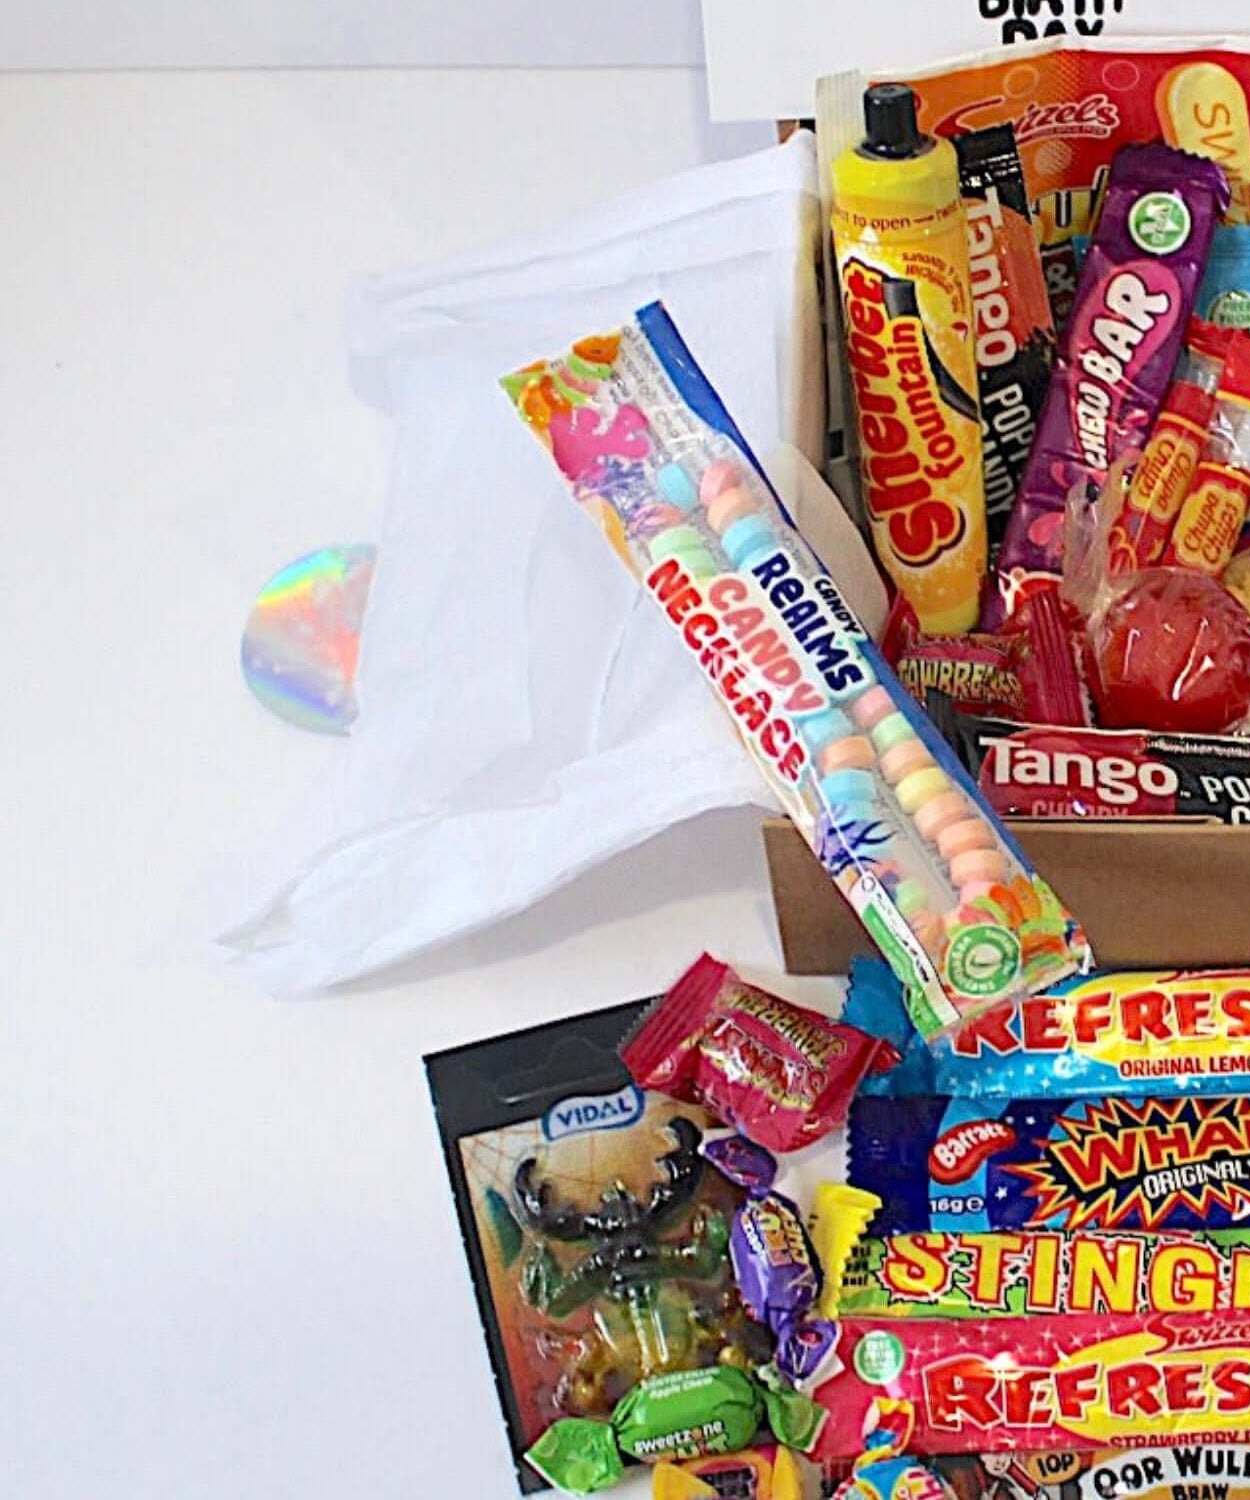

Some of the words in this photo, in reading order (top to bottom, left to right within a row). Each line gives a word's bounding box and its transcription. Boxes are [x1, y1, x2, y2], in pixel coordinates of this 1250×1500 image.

[967, 186, 1017, 366] Tango
[1080, 272, 1172, 386] BAR
[845, 266, 957, 560] Sherbet
[889, 320, 965, 480] fountain
[1183, 490, 1219, 553] Chupa
[1201, 500, 1240, 566] Chups
[814, 577, 862, 637] CANDY
[646, 558, 806, 782] NECKLACE
[709, 577, 826, 712] CANDY
[978, 737, 1179, 804] Tango
[1119, 1058, 1204, 1077] ORIGINAL
[556, 1097, 634, 1128] VIDAL
[932, 1121, 1008, 1170] Barratt
[1142, 1161, 1249, 1199] ORIGINAL
[1109, 1428, 1238, 1449] STRAWBERRY
